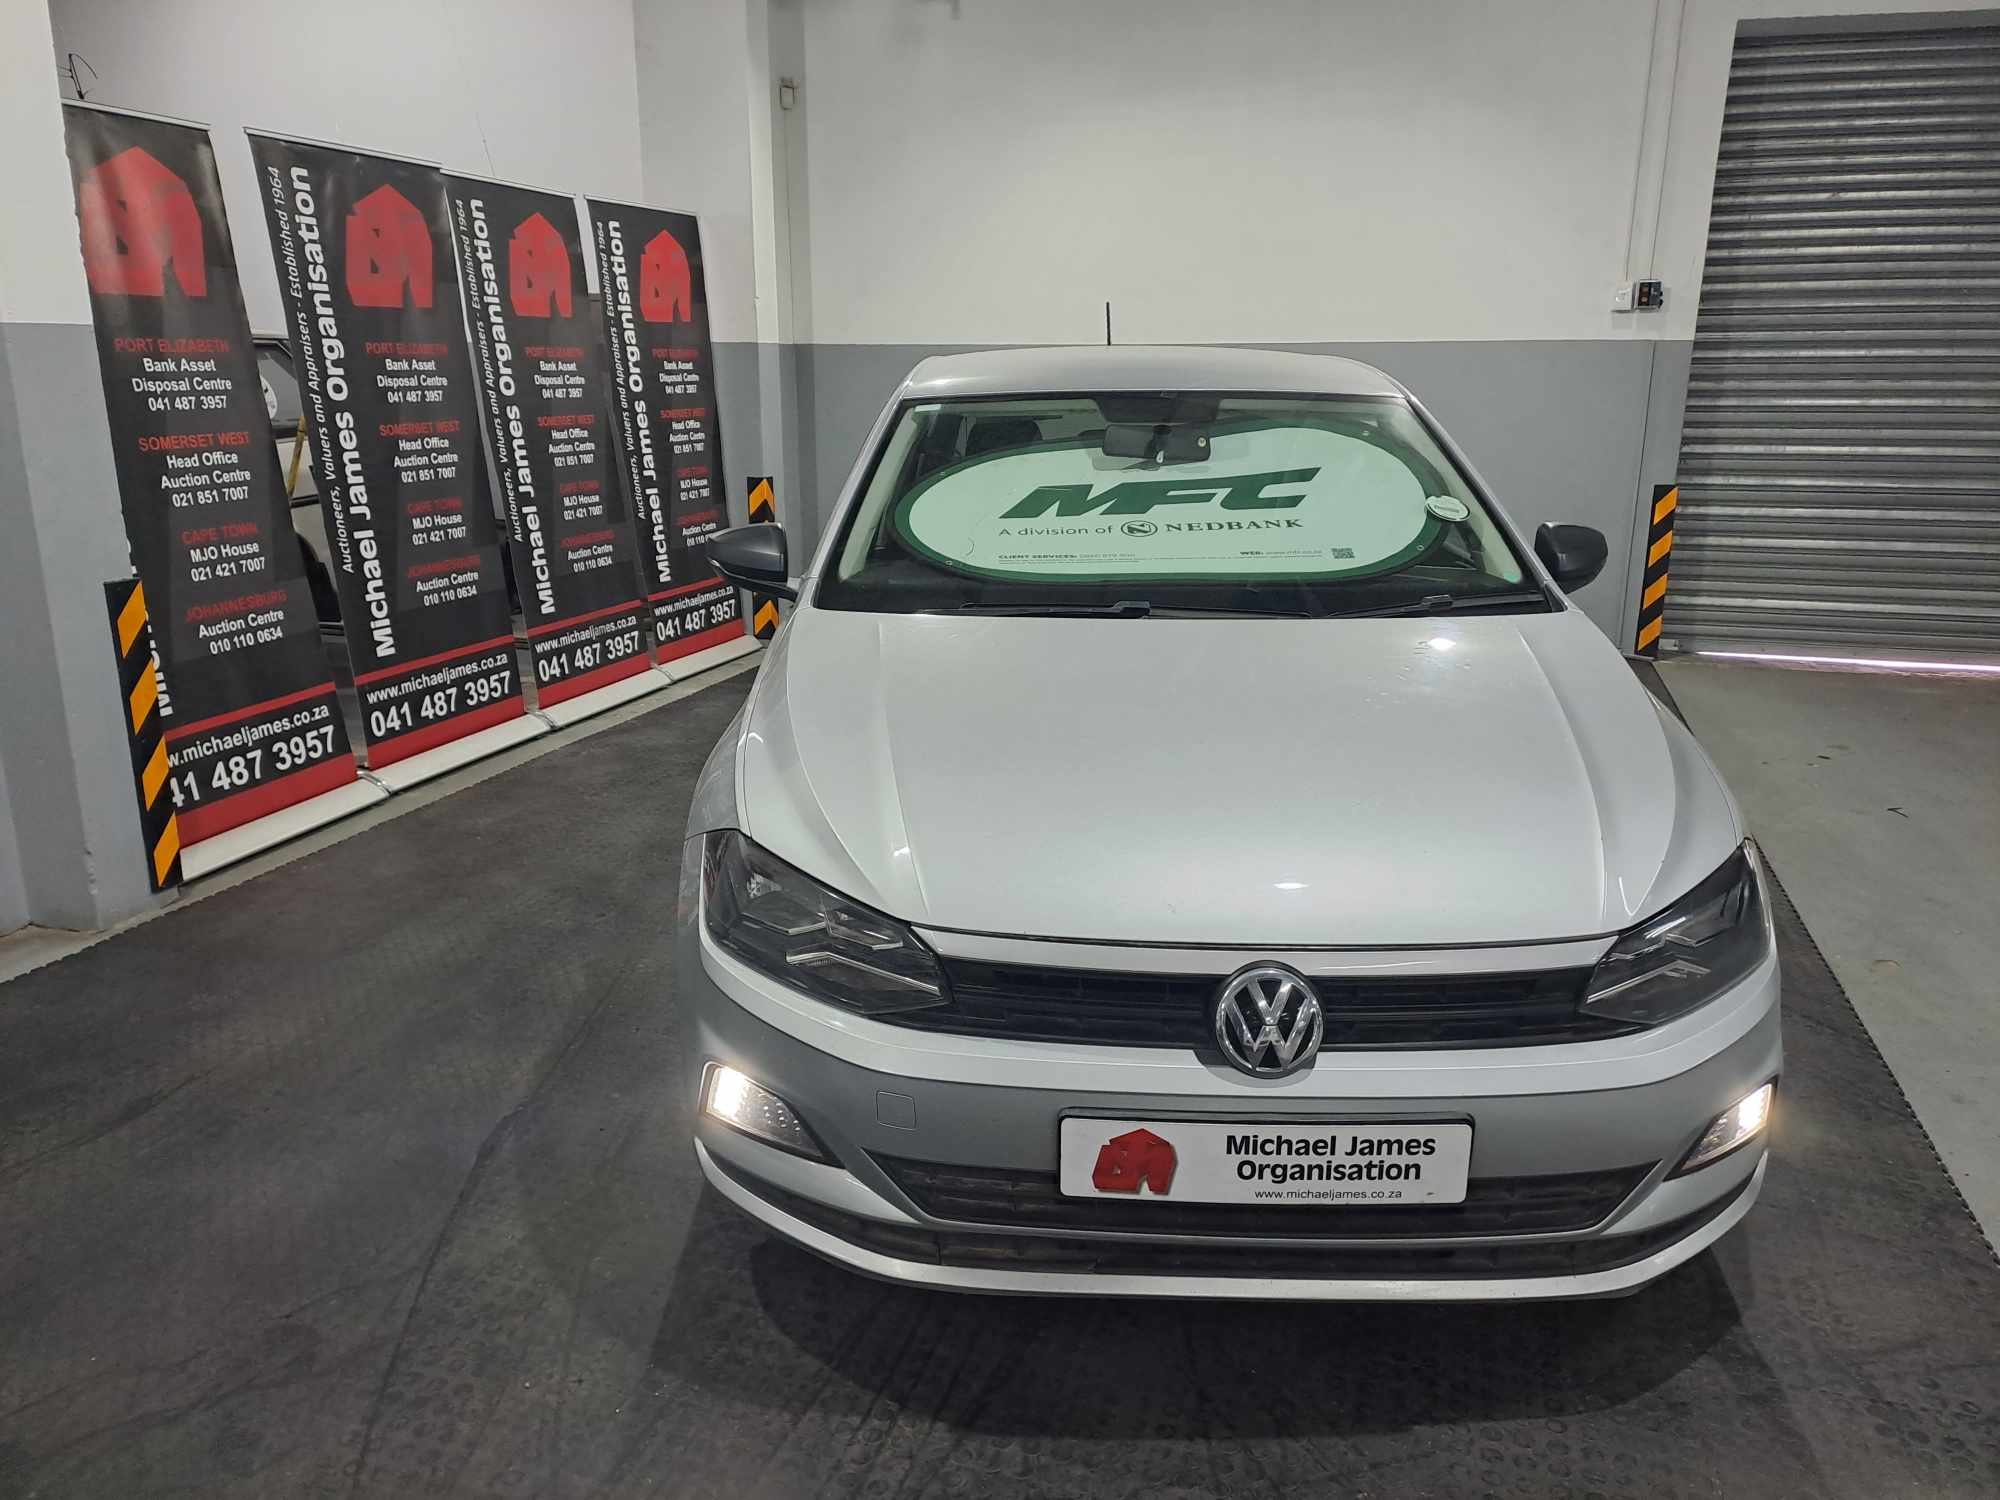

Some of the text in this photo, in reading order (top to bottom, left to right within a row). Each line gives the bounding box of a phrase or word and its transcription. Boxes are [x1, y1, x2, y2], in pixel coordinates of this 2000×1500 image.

[113, 338, 152, 352] PORT
[143, 358, 216, 372] Bank Asset
[267, 166, 355, 574] Auctioneers, Valuers and Appraisers Established 1964
[386, 358, 436, 370] Bank Asset
[456, 199, 523, 542] Auctioneers, Valuers and Appraisers Established 1964
[540, 360, 557, 371] Bank
[132, 376, 232, 394] Disposal Centre
[377, 374, 448, 388] Disposal Centre
[148, 396, 226, 411] 041 487 3957
[388, 390, 443, 402] 041 487 3957
[608, 220, 672, 582] Michael James Organisation
[617, 386, 628, 408] and
[290, 166, 396, 658] Michael James Organisation
[470, 199, 556, 614] Michael James Organisation
[138, 432, 248, 451] SOMERSET WEST
[398, 437, 449, 451] Head Office
[548, 444, 574, 454] Auction
[166, 452, 238, 468] Head Office
[394, 453, 458, 468] Auction Centre
[161, 469, 250, 489] Auction Centre
[402, 467, 456, 483] 021 851 7007
[172, 486, 249, 507] 021 851 7007
[998, 466, 1322, 518] MFC
[412, 514, 462, 529] MJO House
[998, 518, 1304, 536] A division of NEDBANK
[181, 522, 257, 544] CAPE TOWN
[412, 526, 466, 545] 021 421 7007
[190, 542, 259, 562] MJO House
[568, 548, 591, 560] Auction
[191, 557, 265, 582] 021 421 7007
[416, 572, 478, 592] Auction Centre
[186, 590, 288, 622] JOHANNESBURG
[424, 586, 478, 606] 010 110 0634
[199, 609, 284, 638] Auction Centre
[656, 600, 736, 641] 041 487 3957
[210, 626, 283, 655] 010 110 0634
[534, 614, 636, 654] www.michaeljames.co.za
[538, 630, 640, 682] 041 487 3957
[366, 653, 508, 704] www.michaeljames.co.za
[370, 672, 510, 737] 041 487 3957
[168, 704, 330, 767] w.michaeljames.co.za
[211, 750, 263, 790] 487
[272, 724, 337, 770] 3957
[1225, 1135, 1436, 1156] Michael James
[1236, 1160, 1421, 1184] Organisation
[1254, 1188, 1402, 1202] www.michaeljames.co.za
